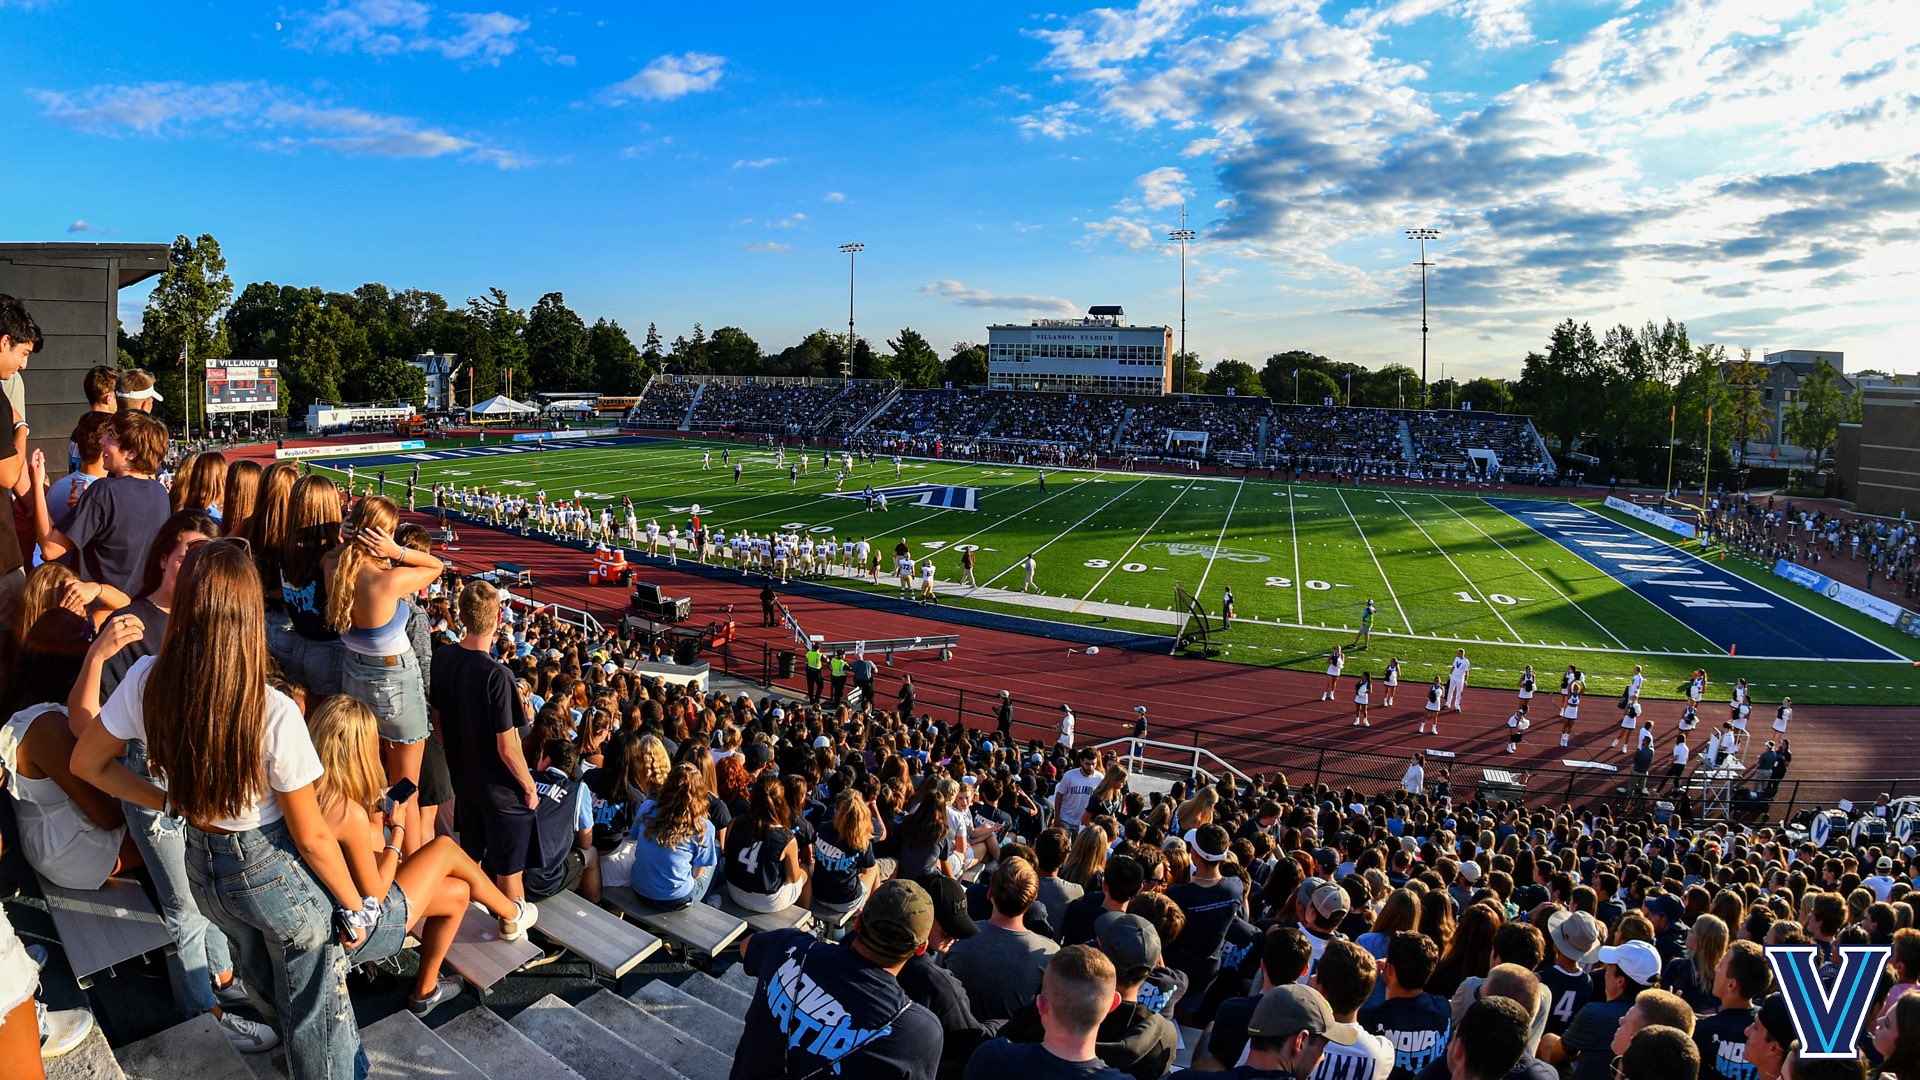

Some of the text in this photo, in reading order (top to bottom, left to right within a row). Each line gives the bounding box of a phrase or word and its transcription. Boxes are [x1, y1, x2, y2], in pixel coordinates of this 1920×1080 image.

[1226, 387, 1235, 396] SC
[1324, 397, 1333, 406] SB
[1462, 401, 1471, 410] SA
[598, 566, 608, 577] G
[902, 563, 911, 571] 72
[1083, 558, 1149, 573] 30
[1265, 576, 1333, 591] 20
[1452, 591, 1517, 605] 10
[1815, 818, 1832, 841] V
[738, 841, 763, 874] 4
[777, 957, 851, 1026] NOVA
[1554, 990, 1577, 1022] 4
[1717, 1040, 1748, 1063] NO
